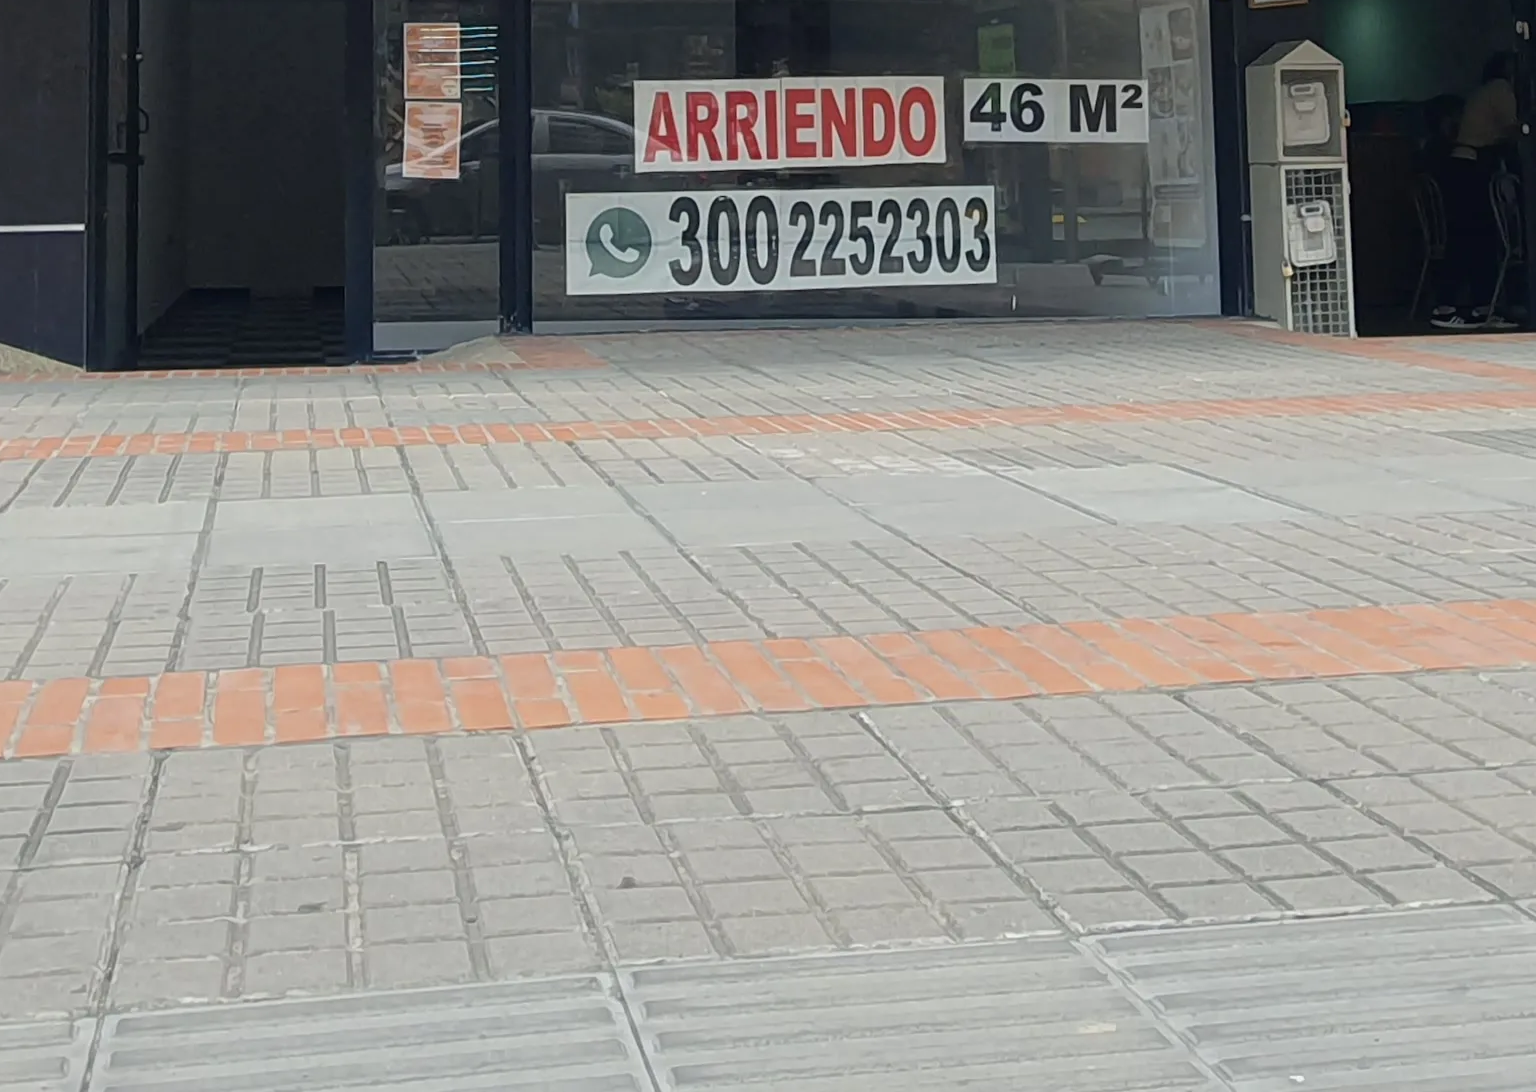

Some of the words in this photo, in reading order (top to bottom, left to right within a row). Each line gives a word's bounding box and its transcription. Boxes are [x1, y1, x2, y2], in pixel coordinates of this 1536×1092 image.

[643, 86, 937, 163] ARRIENDO
[970, 82, 1045, 133] 46
[1069, 84, 1143, 133] M²
[669, 195, 779, 287] 300
[789, 197, 991, 278] 2252303
